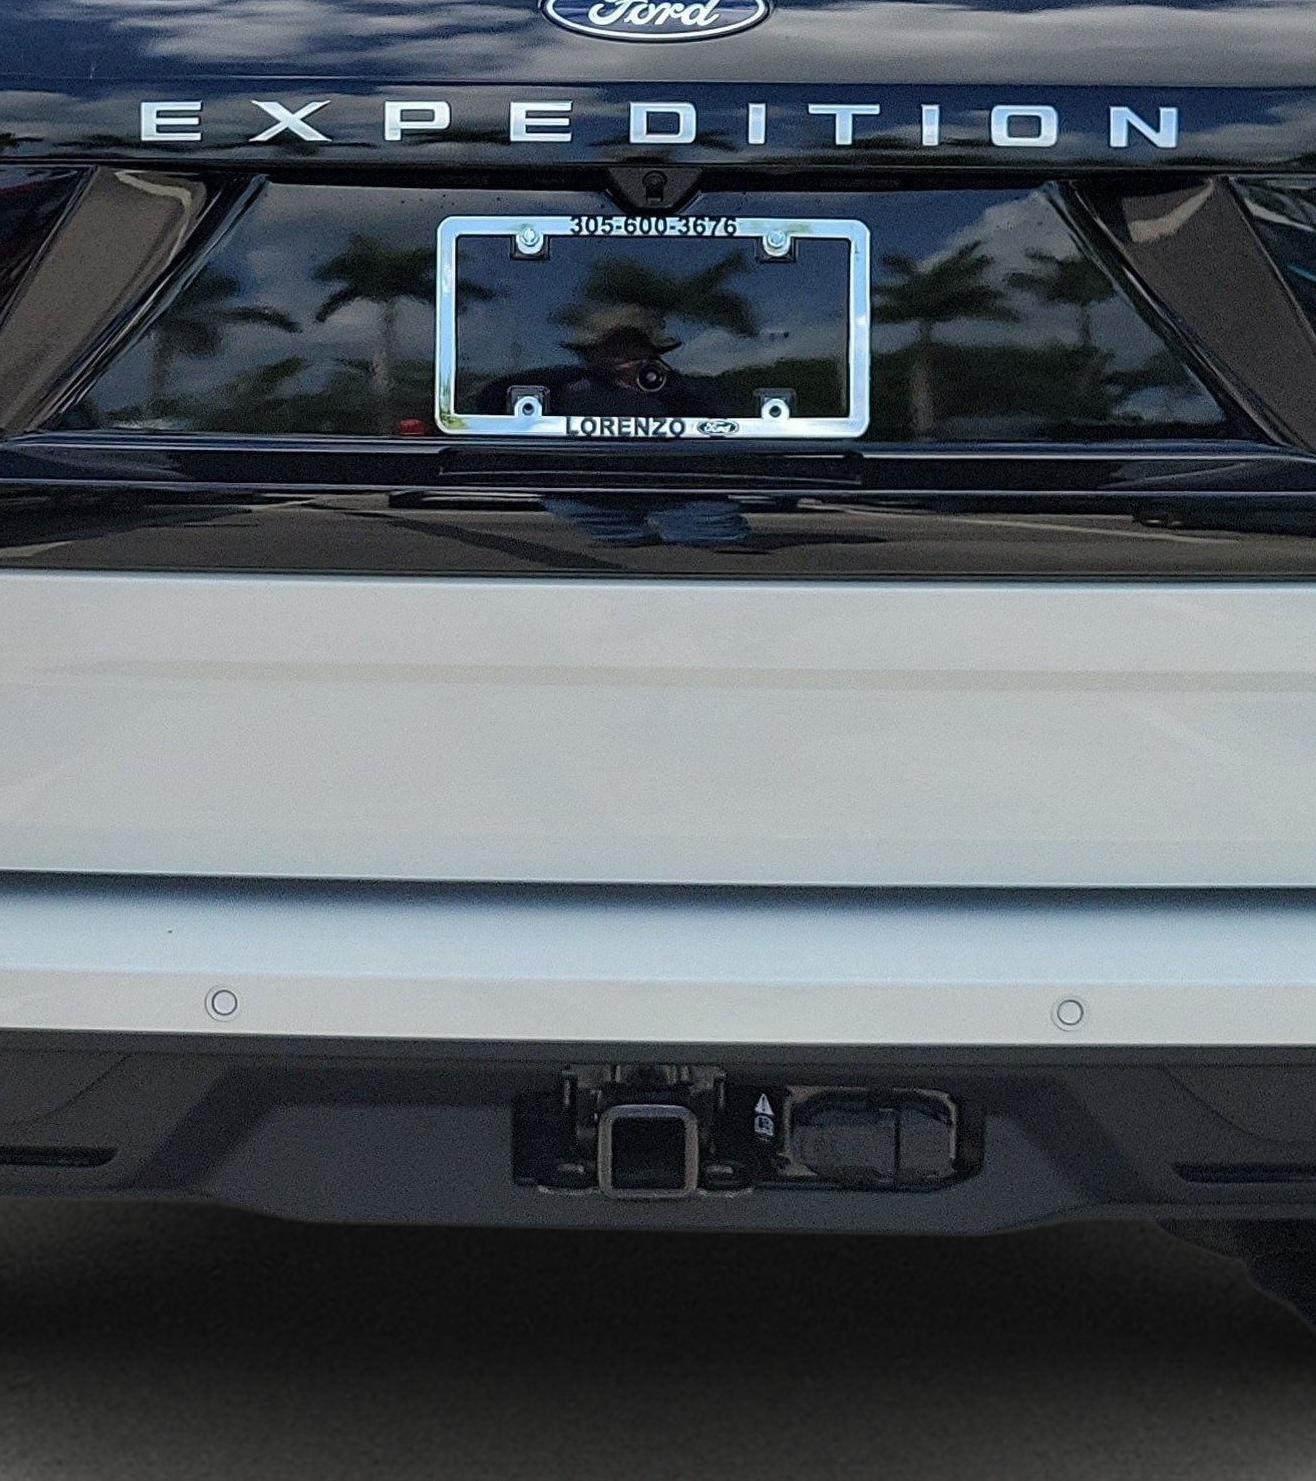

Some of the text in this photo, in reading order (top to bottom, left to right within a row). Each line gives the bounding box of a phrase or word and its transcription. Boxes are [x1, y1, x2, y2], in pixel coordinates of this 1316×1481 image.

[140, 99, 1178, 149] EXPEDITION
[569, 216, 738, 237] 305-600-3676
[565, 417, 686, 438] LORENZO
